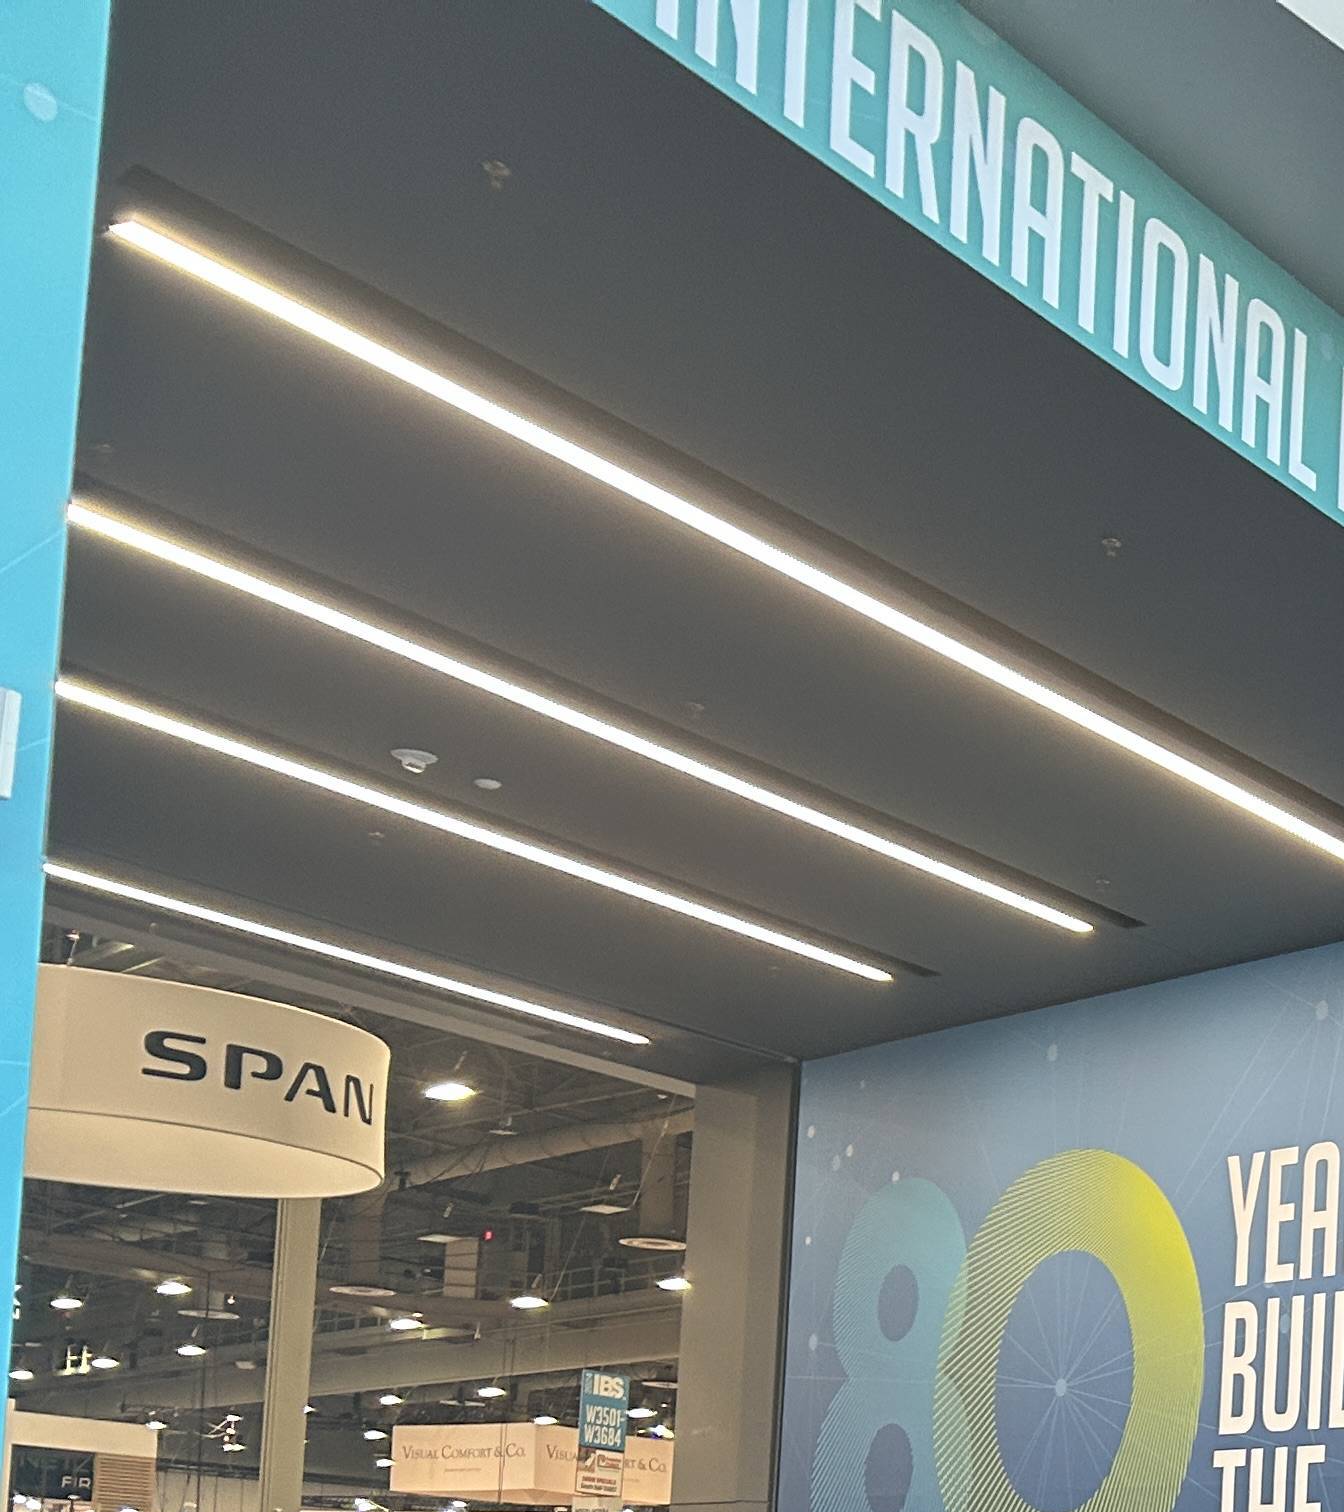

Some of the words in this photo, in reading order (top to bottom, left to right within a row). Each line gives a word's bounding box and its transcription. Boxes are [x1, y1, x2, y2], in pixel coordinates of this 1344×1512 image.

[142, 1030, 375, 1126] SPAN
[592, 1374, 625, 1399] IBS
[584, 1425, 622, 1448] W3684
